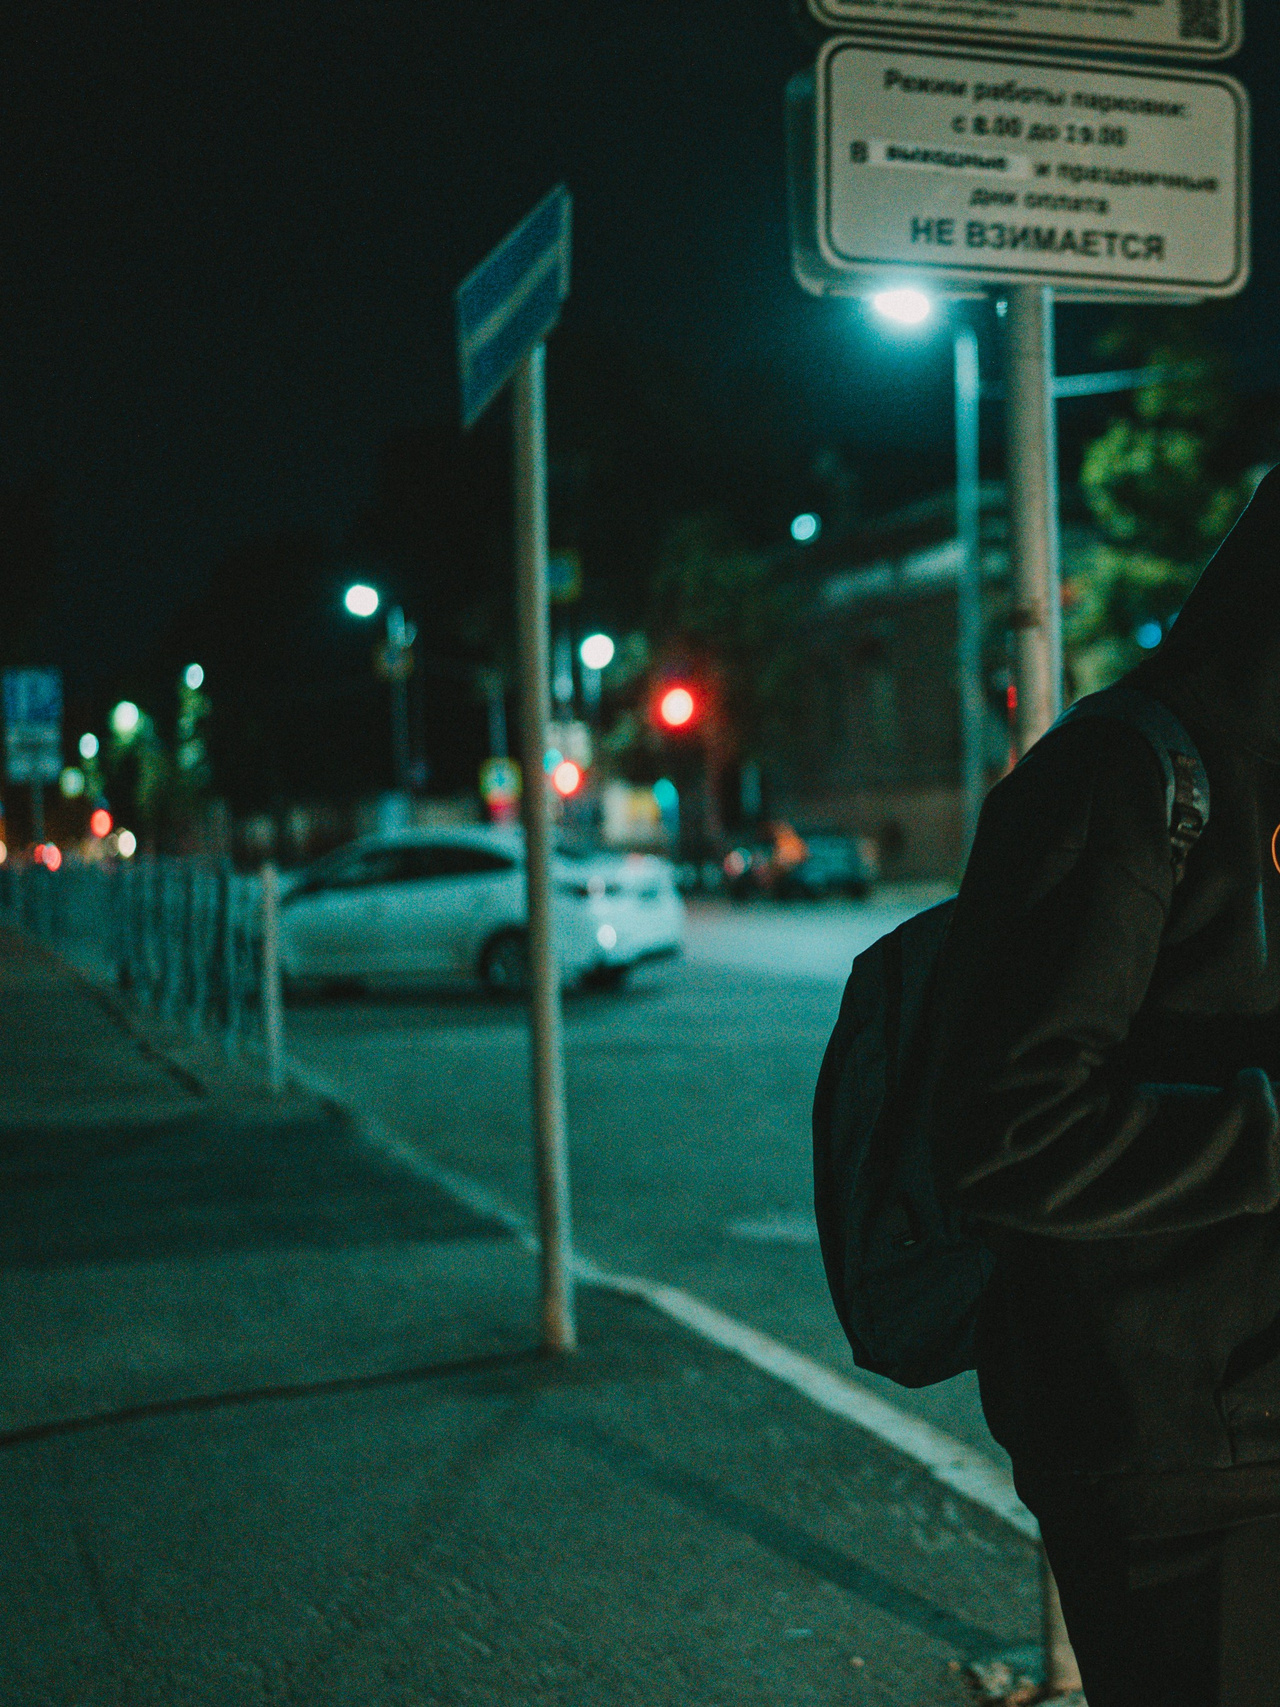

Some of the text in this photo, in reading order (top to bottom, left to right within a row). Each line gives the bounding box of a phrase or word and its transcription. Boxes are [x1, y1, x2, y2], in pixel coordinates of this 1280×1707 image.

[884, 69, 967, 96] Режим
[973, 80, 1065, 106] работы
[952, 116, 967, 134] с
[1027, 123, 1060, 142] до
[850, 141, 1219, 193] В выходные и праздничные
[970, 188, 1109, 214] дни оплата
[911, 217, 1164, 260] НЕ ВЗИМАЕТСЯ
